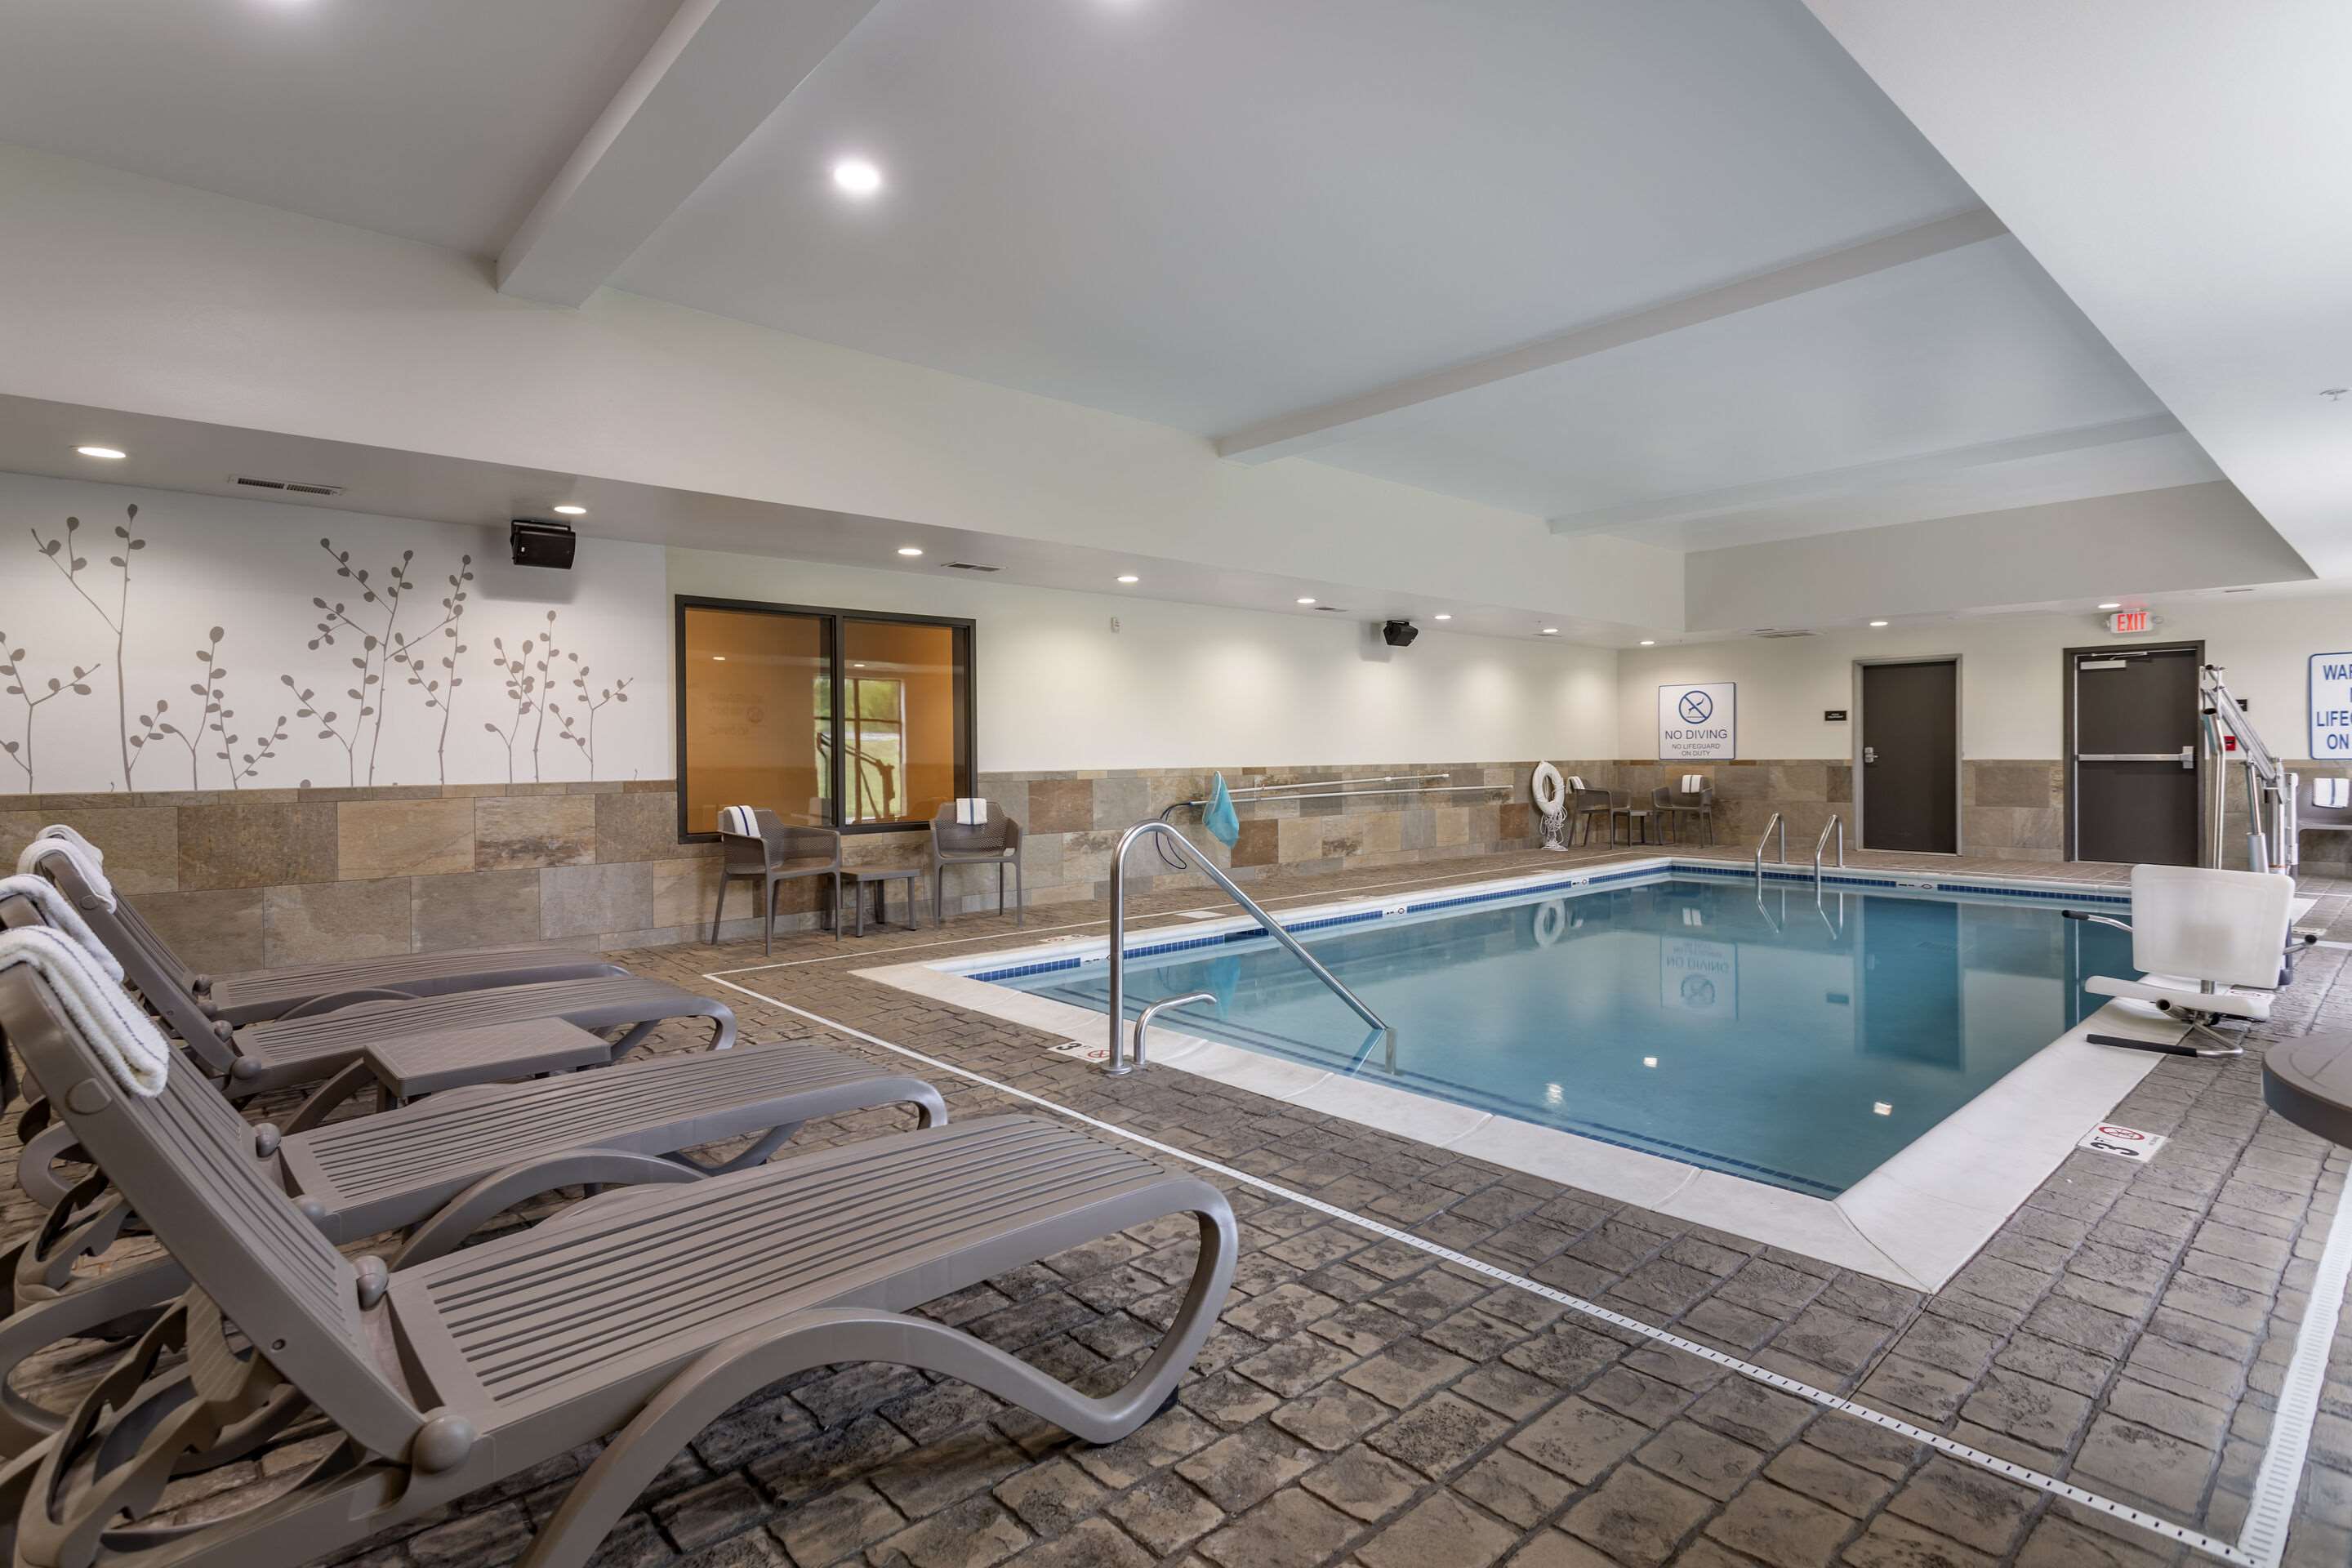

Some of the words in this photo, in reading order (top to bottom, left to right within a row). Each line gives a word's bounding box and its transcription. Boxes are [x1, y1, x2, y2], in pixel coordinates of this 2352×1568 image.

[2117, 612, 2147, 631] EXIT
[2323, 664, 2352, 680] WA
[2316, 710, 2352, 727] LIFE
[1665, 730, 1682, 740] NO
[1686, 728, 1728, 739] DIVING
[2327, 733, 2350, 750] ON
[2090, 1142, 2140, 1156] 3
